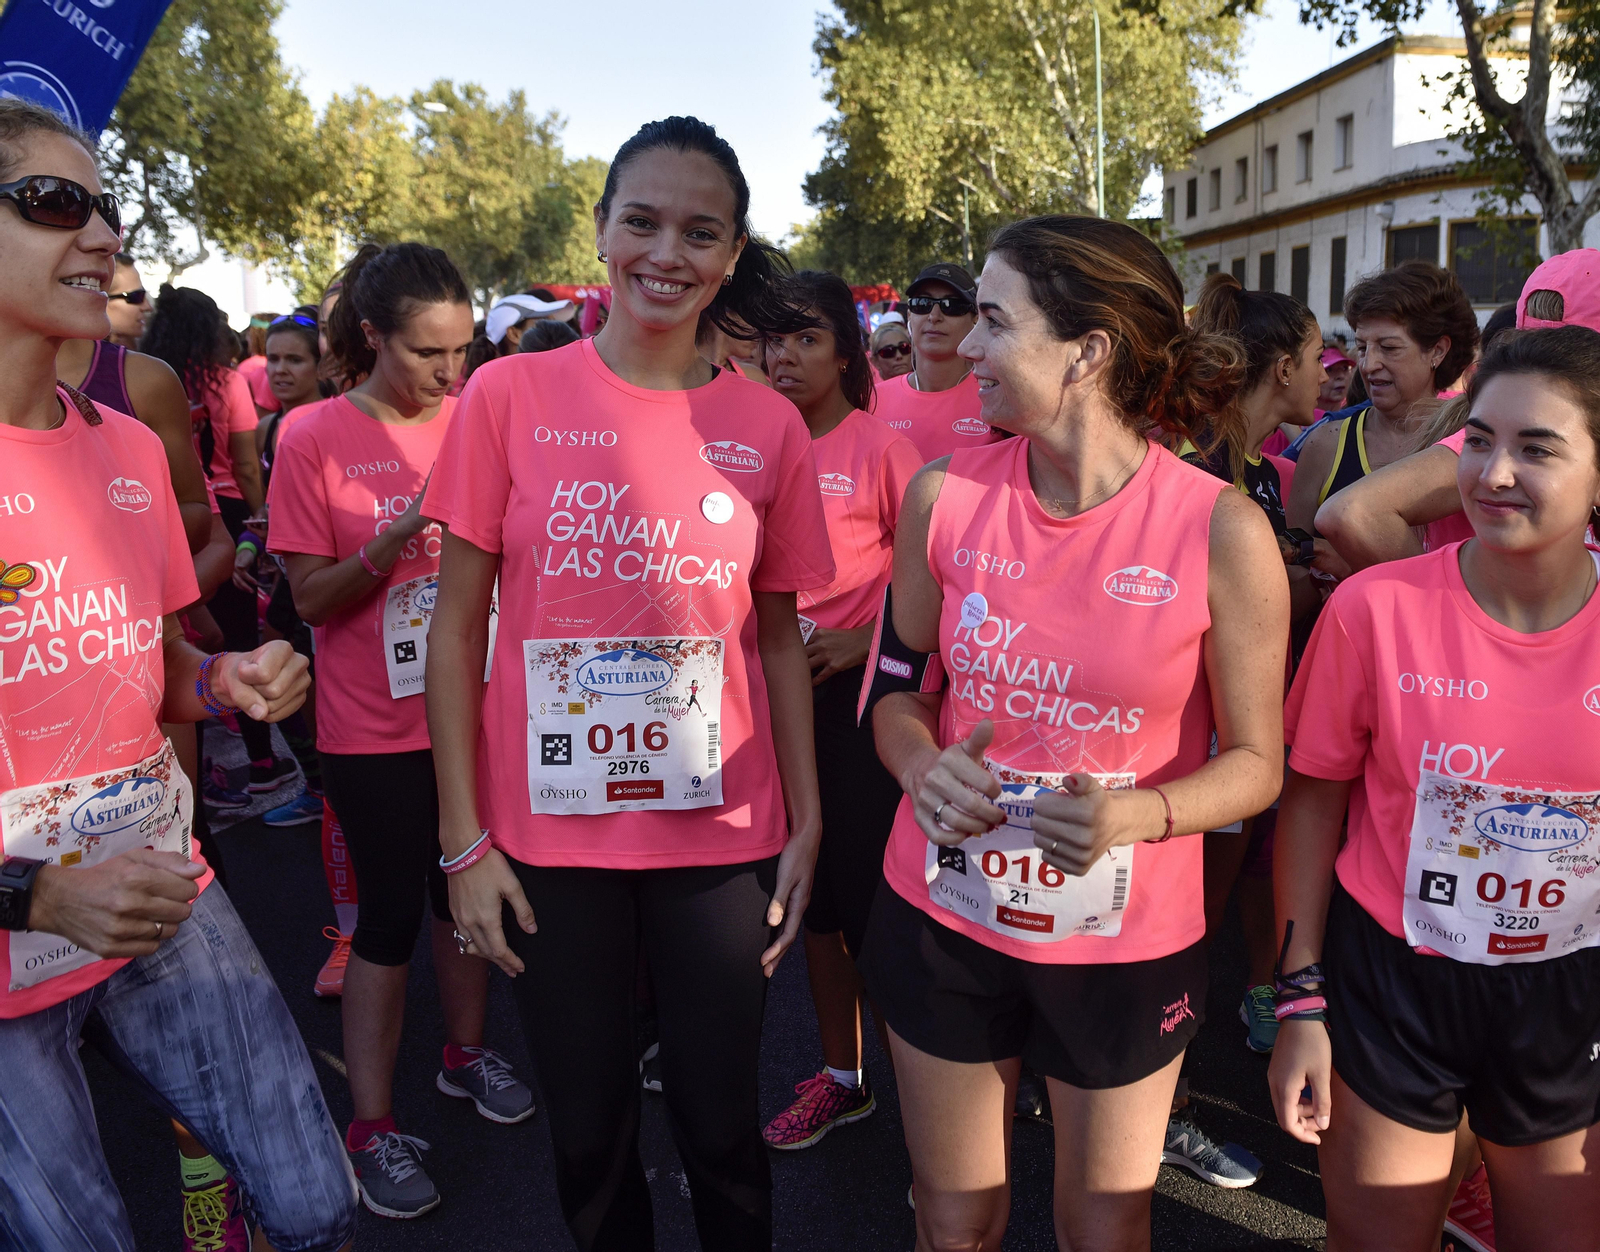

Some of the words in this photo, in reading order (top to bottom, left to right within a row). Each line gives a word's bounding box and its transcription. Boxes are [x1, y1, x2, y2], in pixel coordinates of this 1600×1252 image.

[42, 0, 126, 60] URICH
[534, 426, 618, 447] OYSHO
[704, 448, 759, 468] ASTURIANA
[346, 460, 400, 478] OYSHO
[550, 480, 631, 511] HOY
[546, 511, 682, 549] GANAN
[543, 546, 604, 578] LAS
[613, 551, 738, 589] CHICAS
[953, 548, 1026, 580] OYSHO
[20, 556, 68, 597] OY
[1109, 577, 1171, 597] ASTURIANA
[0, 584, 127, 643] GANAN
[78, 615, 163, 665] CHICA
[584, 667, 667, 685] ASTURIANA
[881, 658, 910, 676] COSMO
[950, 643, 1074, 694] GANAN
[397, 675, 425, 687] OYSH
[1398, 673, 1489, 700] OYSHO
[645, 694, 680, 706] Carrera
[952, 671, 996, 713] LAS
[1005, 690, 1145, 734] CHICAS
[666, 704, 692, 721] Mujer
[587, 721, 669, 754] 016
[607, 760, 650, 776] 2976
[1418, 740, 1505, 779] HOY
[540, 788, 587, 799] OYSHO
[623, 786, 656, 794] Santander
[683, 790, 711, 800] ZURICH
[80, 791, 160, 830] ASTURIANA
[97, 796, 130, 810] CENTRAL
[1483, 815, 1580, 840] ASTURIANA
[1502, 816, 1540, 826] CENTRAL
[1439, 840, 1453, 848] IMD
[1548, 852, 1589, 863] Carrera
[981, 850, 1065, 888] 016
[1568, 861, 1600, 879] Mujer
[939, 882, 980, 910] OYSHO
[1010, 890, 1029, 905] 21
[1476, 872, 1567, 908] 016
[1476, 902, 1504, 912] TELÉFONO
[1011, 915, 1046, 928] Santander
[1493, 912, 1540, 930] 3220
[1416, 919, 1467, 945] OYSHO
[1506, 941, 1541, 950] Santander
[25, 944, 80, 971] OYSHO
